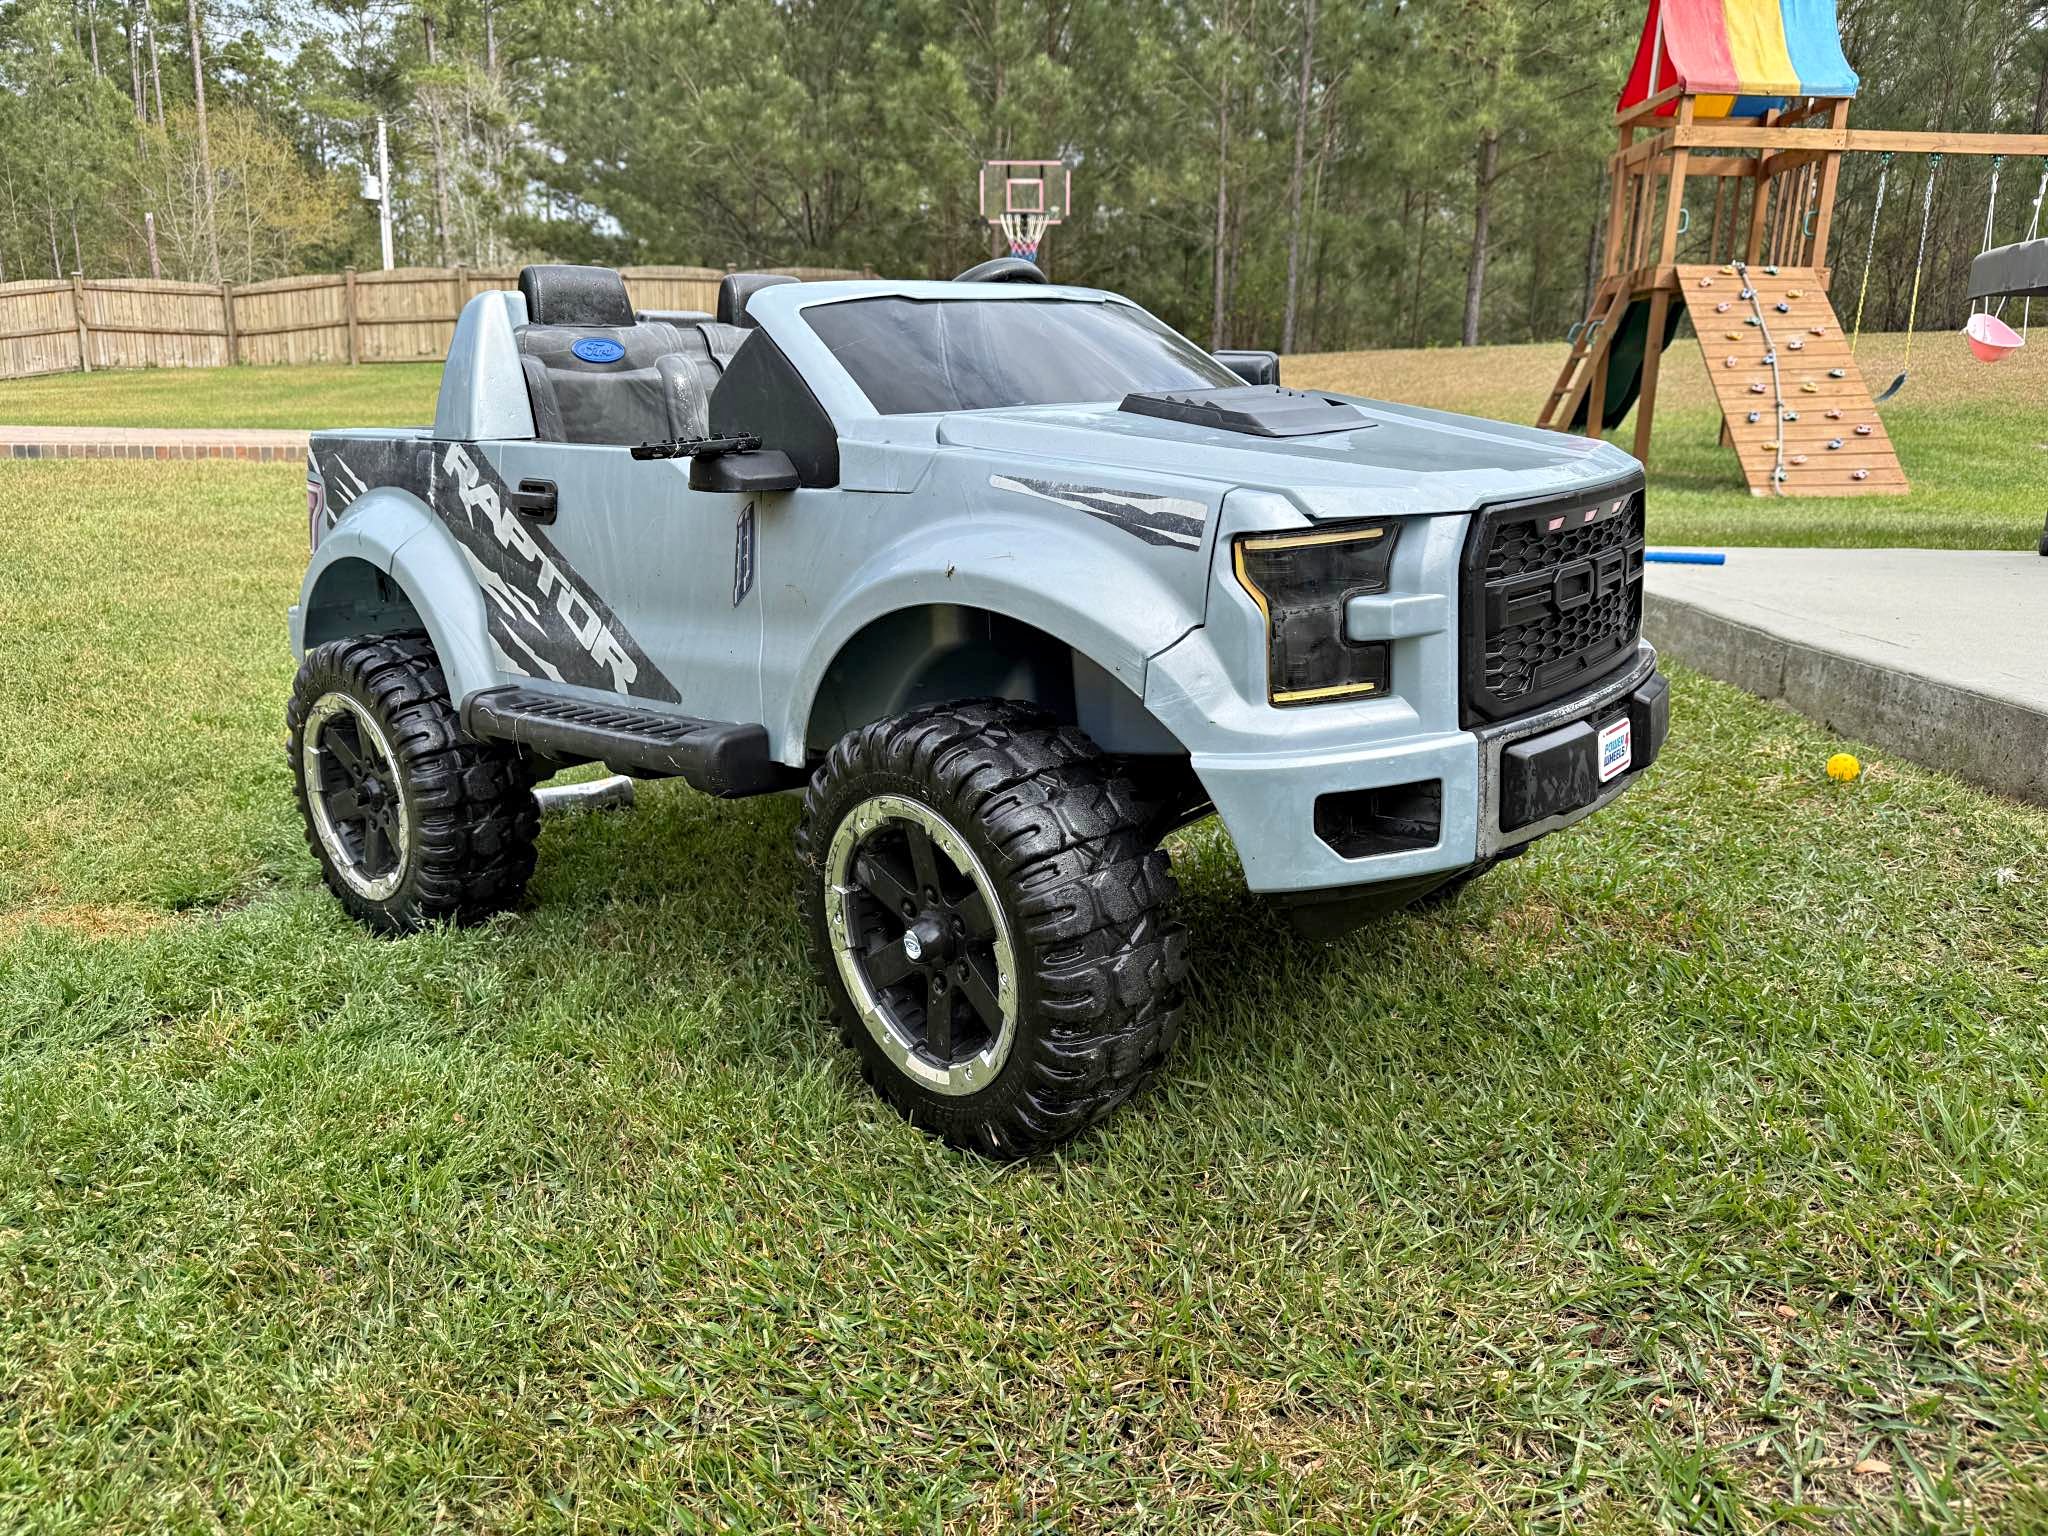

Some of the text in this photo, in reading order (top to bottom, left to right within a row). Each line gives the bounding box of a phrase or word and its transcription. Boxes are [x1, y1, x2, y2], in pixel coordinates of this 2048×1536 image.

[583, 342, 615, 358] Ford
[443, 443, 638, 695] RAPTOR
[1499, 537, 1644, 628] FORD
[1604, 734, 1625, 755] POWER
[1603, 746, 1625, 767] WHEELS
